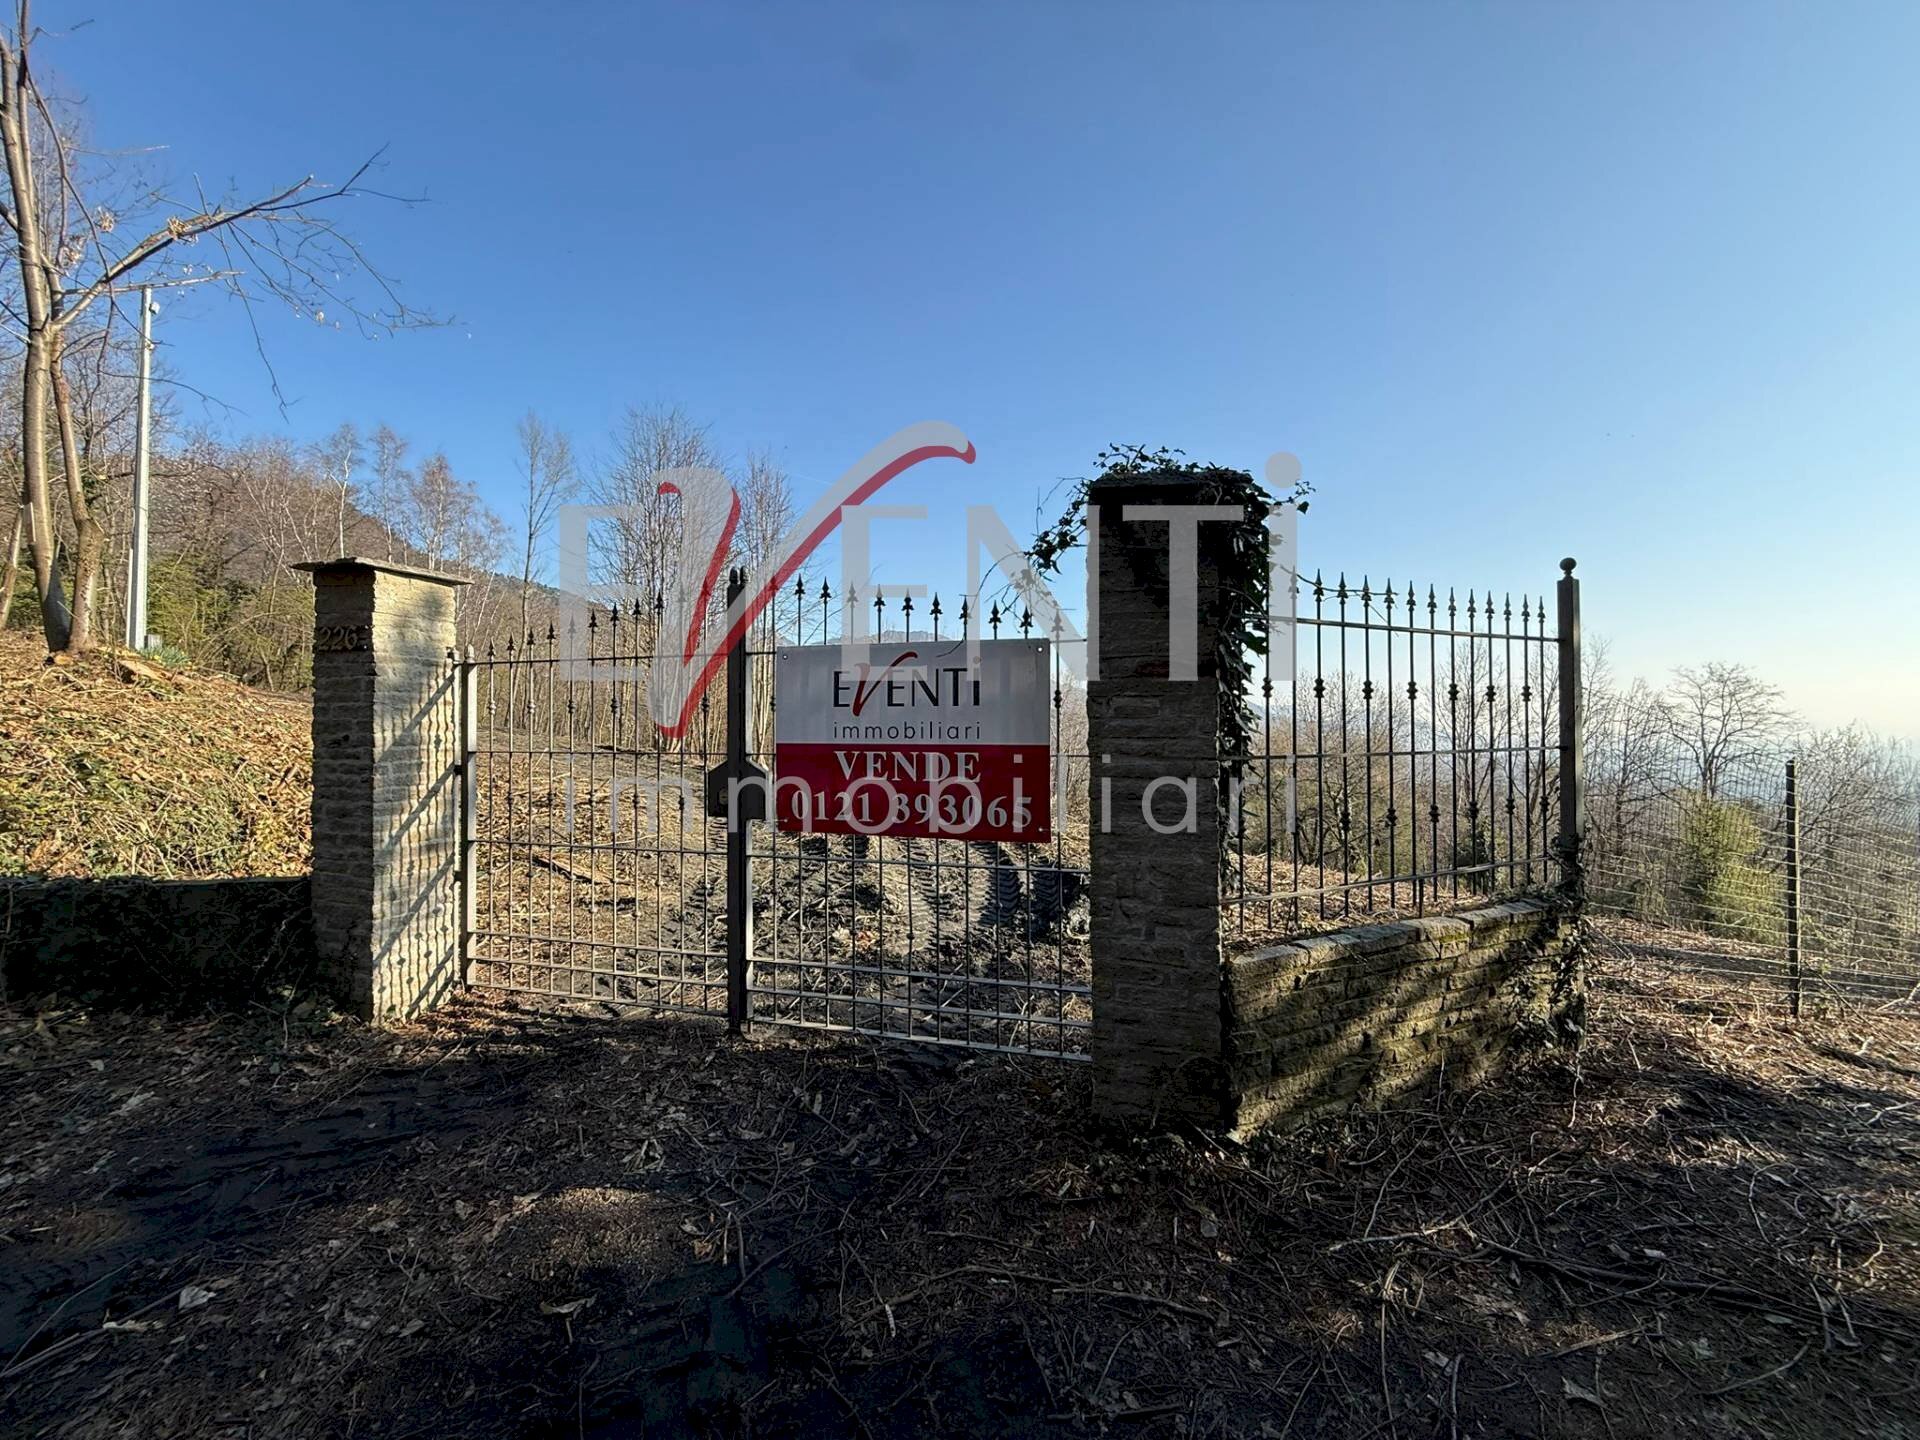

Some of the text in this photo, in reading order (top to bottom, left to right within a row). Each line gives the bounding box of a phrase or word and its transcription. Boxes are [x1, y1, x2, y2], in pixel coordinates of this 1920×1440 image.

[319, 626, 357, 650] 226
[834, 722, 981, 740] immobiliari
[834, 751, 981, 783] VENDE
[791, 790, 1033, 828] 0121 393065
